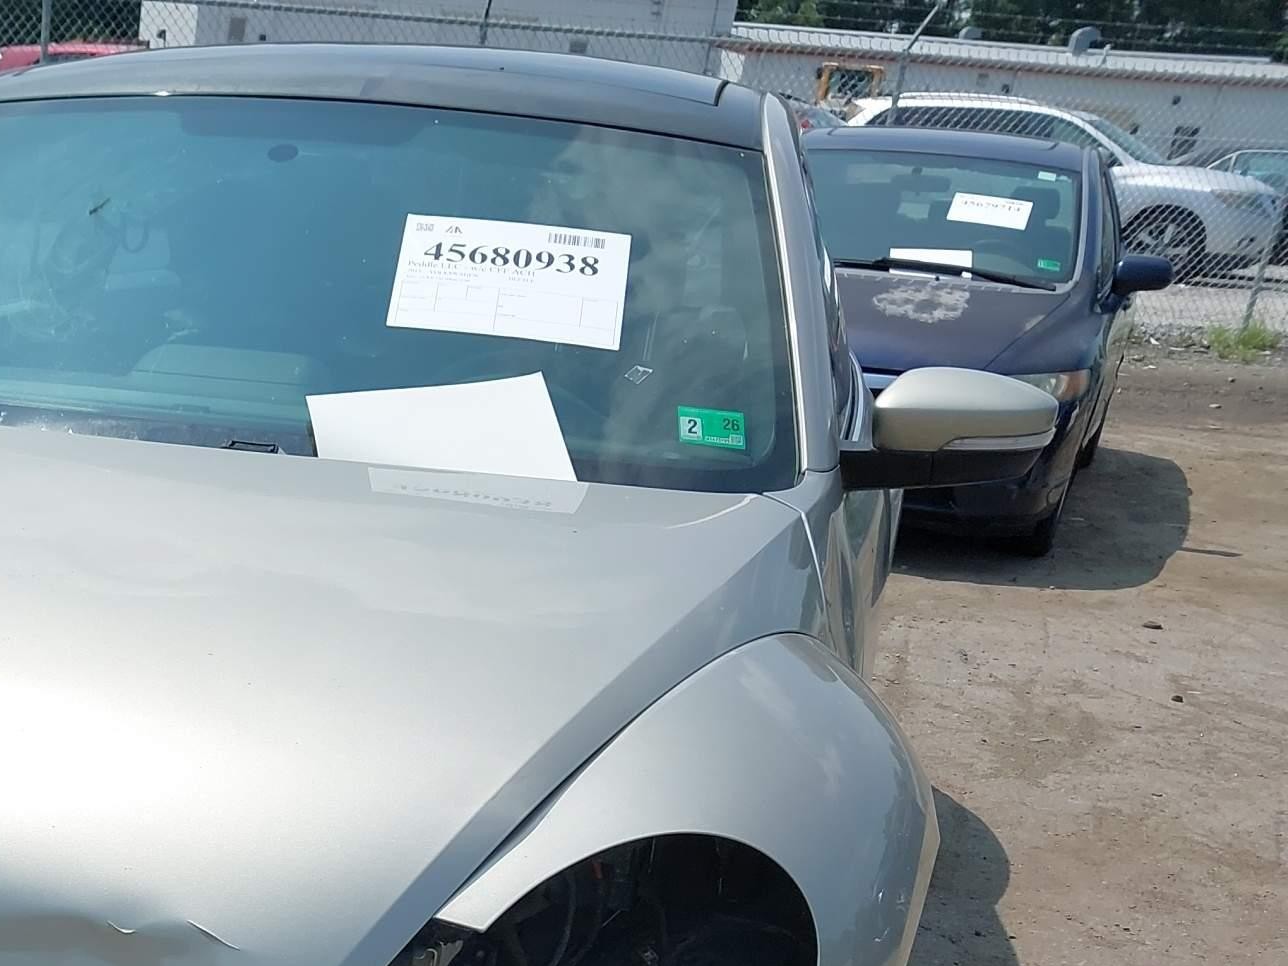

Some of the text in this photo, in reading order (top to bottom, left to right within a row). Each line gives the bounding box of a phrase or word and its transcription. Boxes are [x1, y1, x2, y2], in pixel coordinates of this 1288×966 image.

[423, 241, 600, 277] 45680938
[688, 417, 740, 434] 2 26
